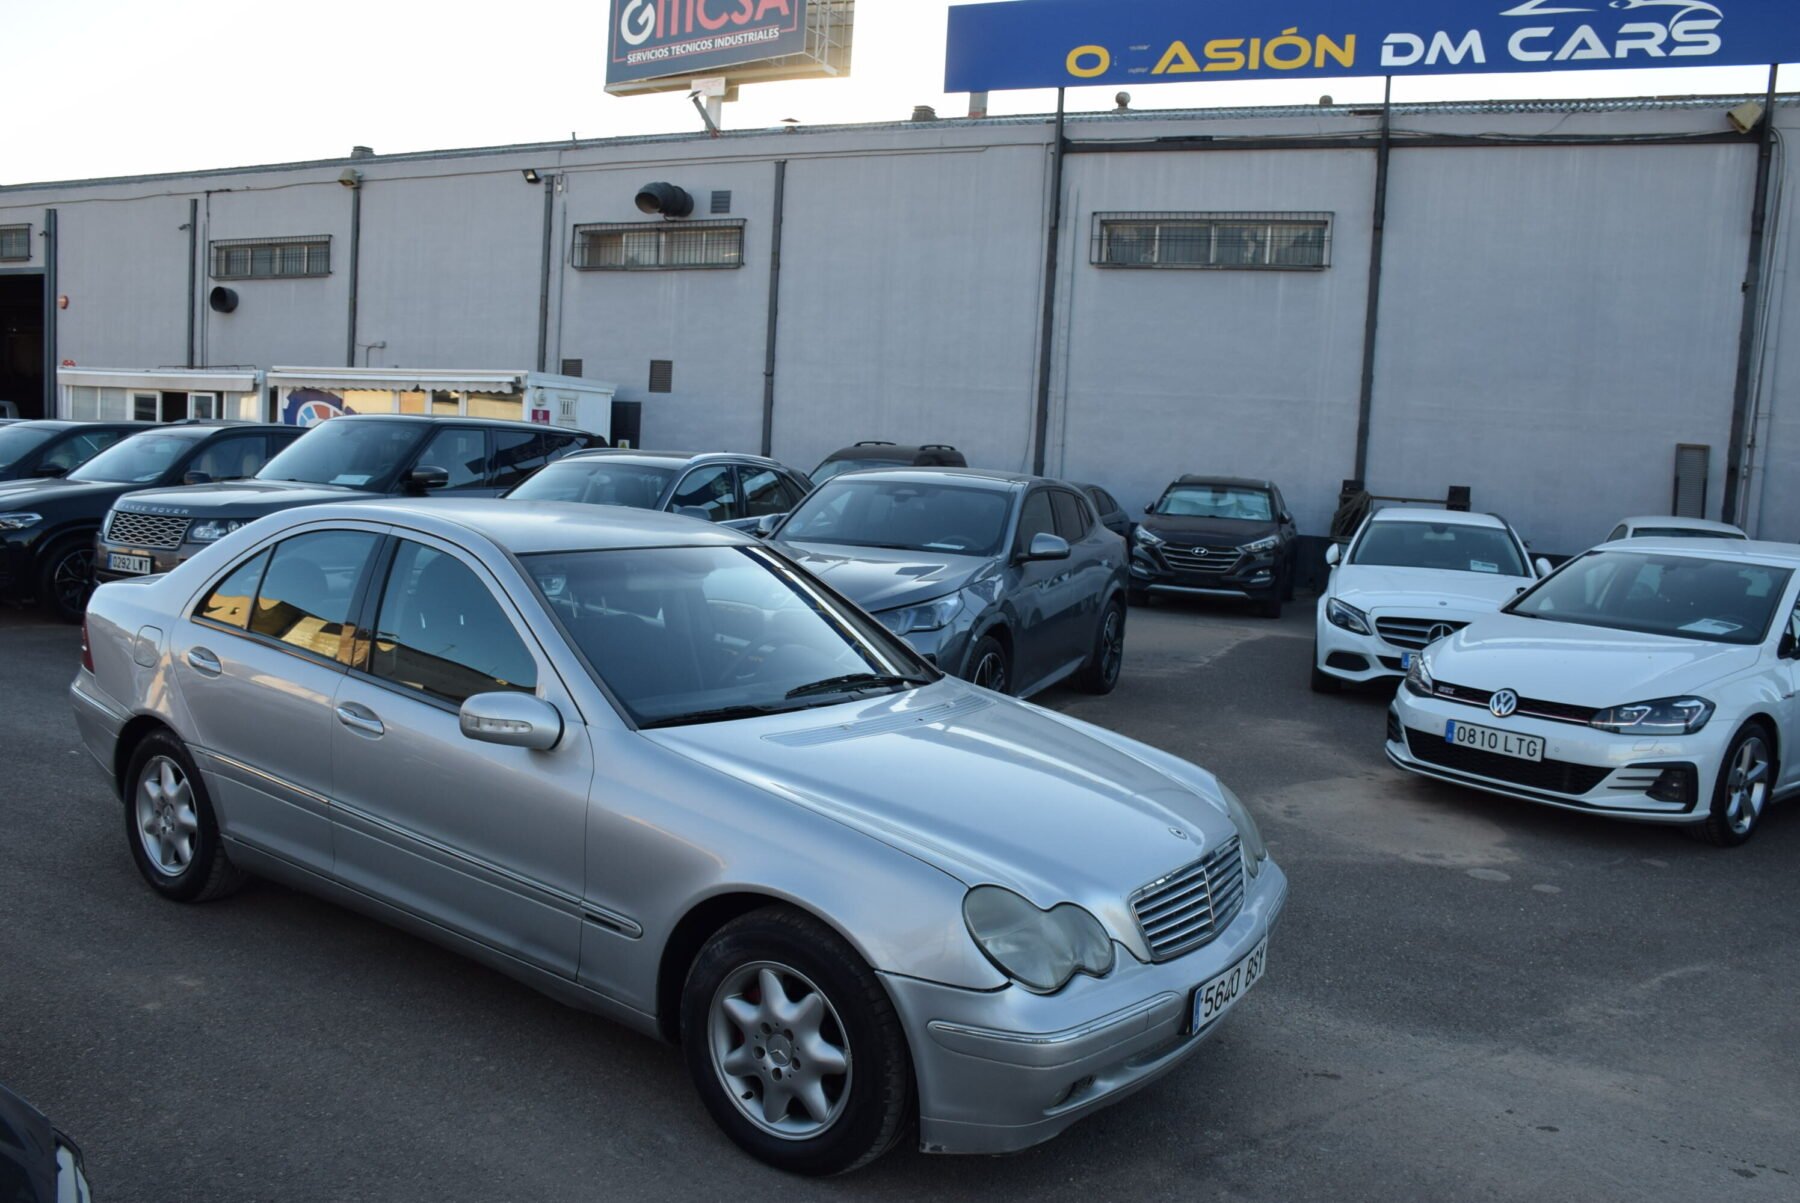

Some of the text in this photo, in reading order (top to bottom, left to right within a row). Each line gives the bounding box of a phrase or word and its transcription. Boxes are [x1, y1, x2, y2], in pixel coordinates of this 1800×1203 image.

[627, 27, 780, 64] SERVICIOS TECNICOS INDUSTRIALES
[1065, 19, 1723, 78] OASIÓN DM CARS
[113, 555, 131, 570] 0292
[1456, 725, 1538, 758] 0810 LTG
[1204, 967, 1241, 1018] 5640
